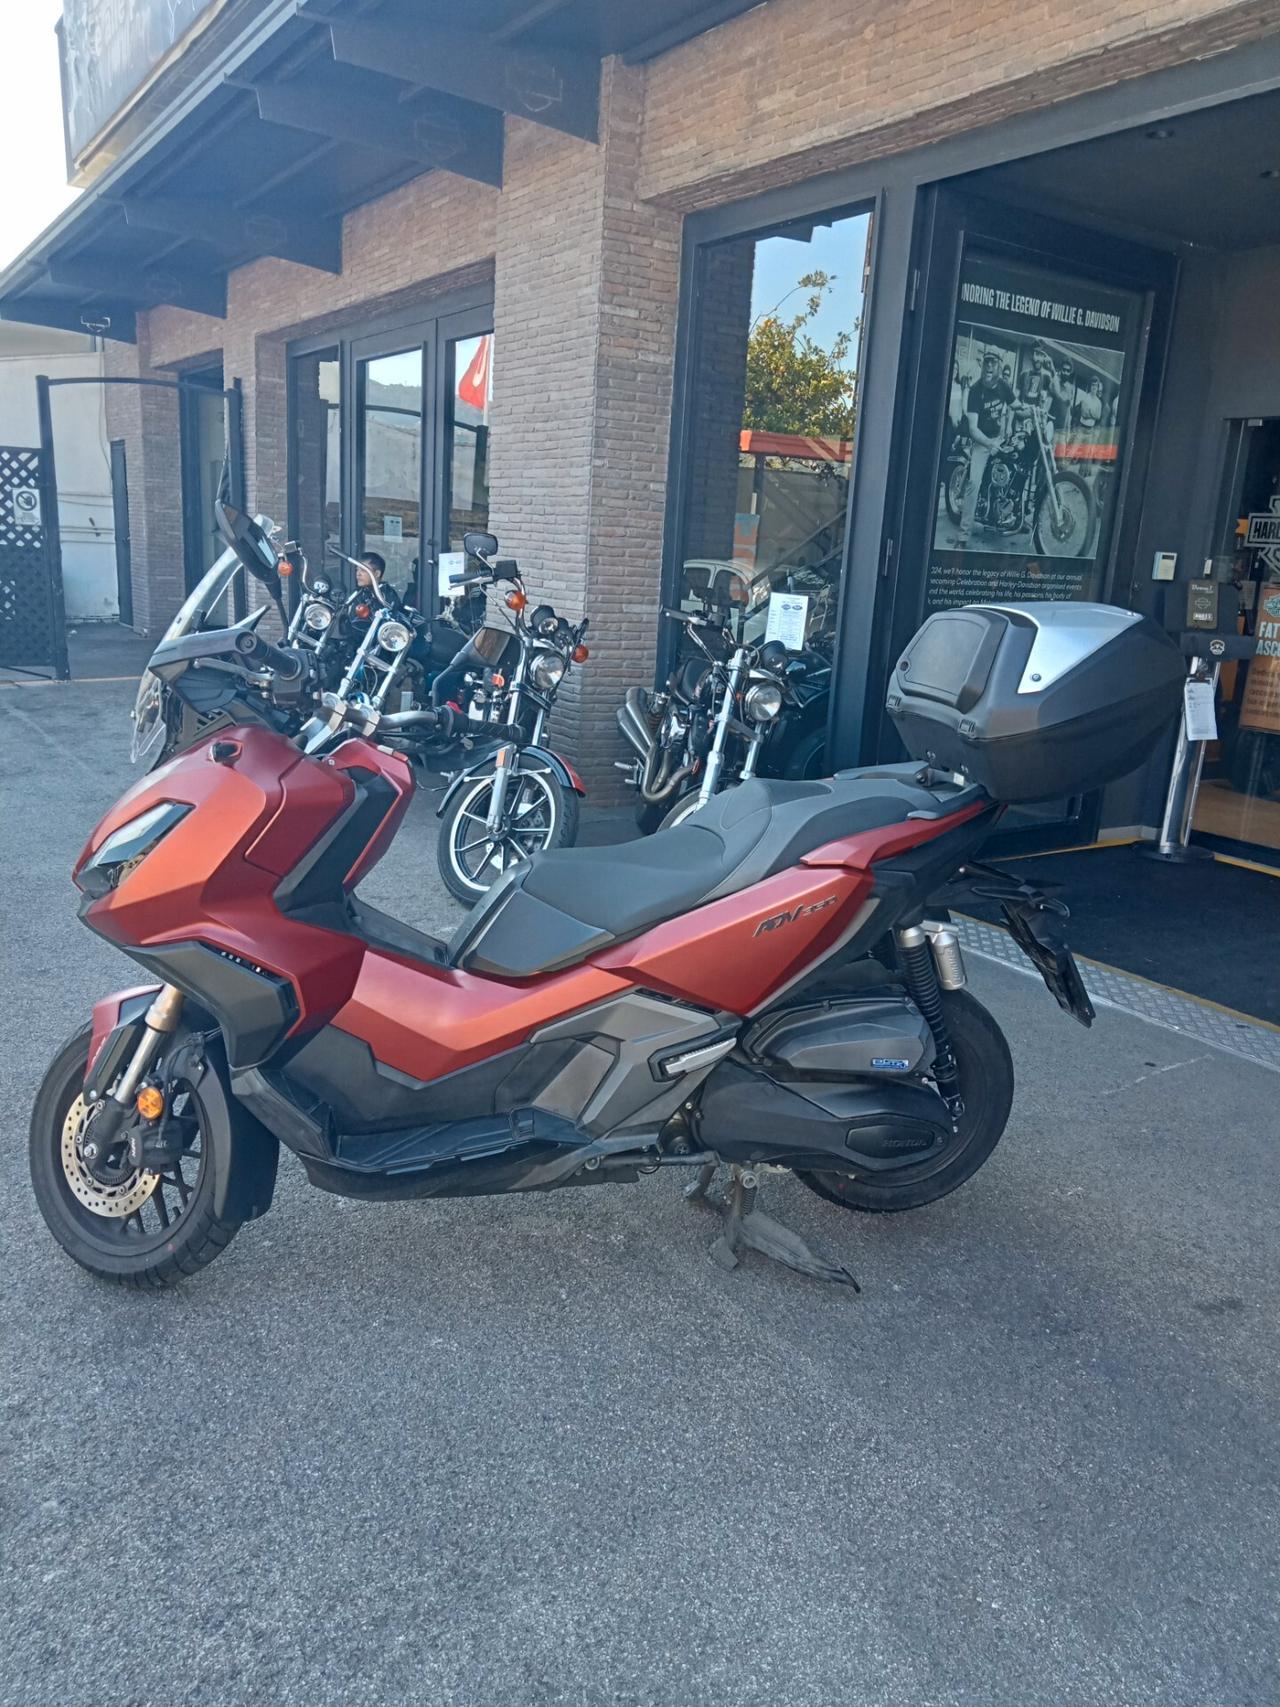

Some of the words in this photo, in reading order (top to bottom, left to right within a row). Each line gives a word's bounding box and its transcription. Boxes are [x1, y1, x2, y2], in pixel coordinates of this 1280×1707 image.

[961, 282, 995, 307] NORING
[995, 290, 1011, 310] THE
[1010, 294, 1041, 317] LEGEND
[1040, 300, 1052, 318] OF
[1051, 303, 1077, 325] WILLIE
[1076, 308, 1084, 326] G.
[1084, 310, 1121, 333] DAVIDSON
[956, 567, 972, 575] honor
[972, 568, 981, 576] the
[981, 568, 999, 578] legacy
[1026, 571, 1051, 579] Davidson
[956, 578, 988, 586] Celebration
[987, 579, 999, 587] and
[998, 580, 1041, 589] Harley-Davidson
[938, 587, 948, 595] the
[965, 589, 996, 598] celebrating
[932, 597, 944, 605] and
[952, 598, 972, 607] impact
